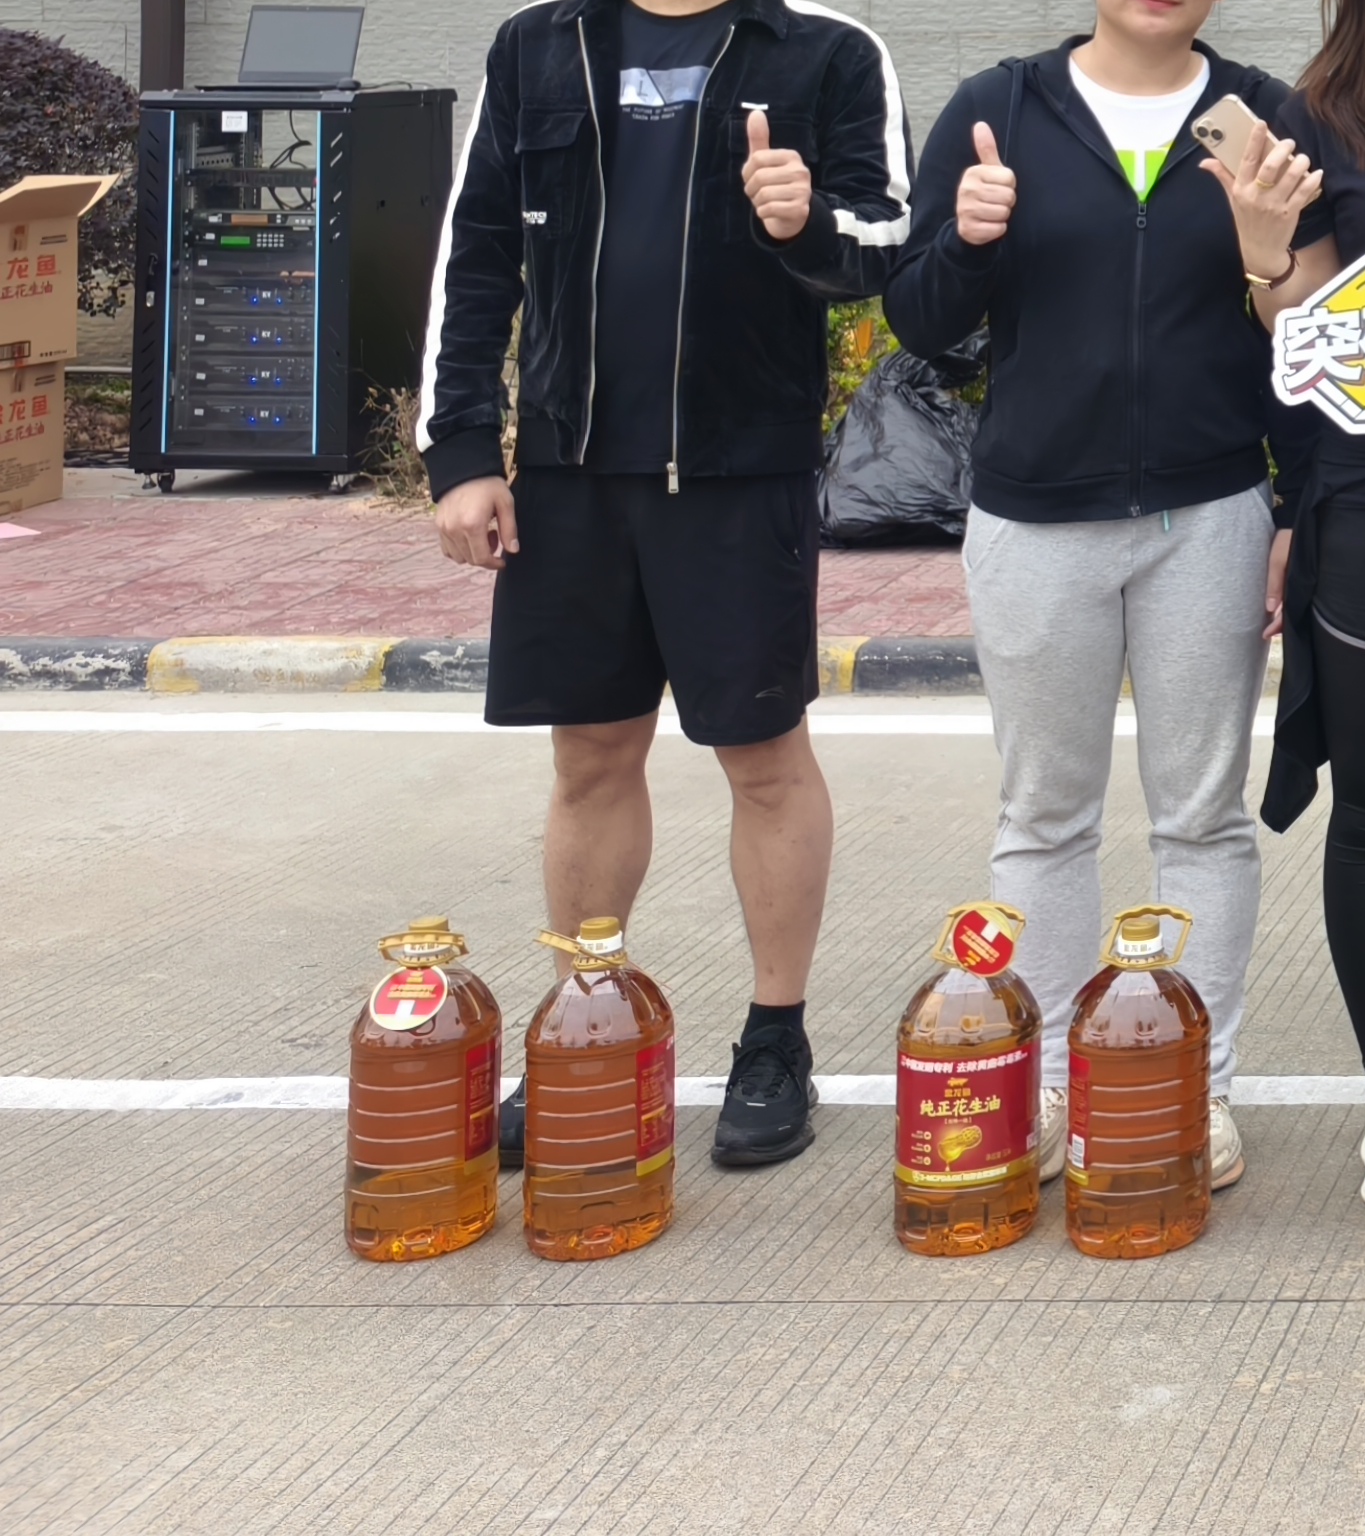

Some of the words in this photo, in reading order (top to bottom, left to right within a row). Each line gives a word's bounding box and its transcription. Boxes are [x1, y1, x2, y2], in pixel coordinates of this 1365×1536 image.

[0, 395, 50, 423] 龙鱼
[0, 422, 45, 444] 正花生油
[920, 1094, 1001, 1117] 纯正花生油
